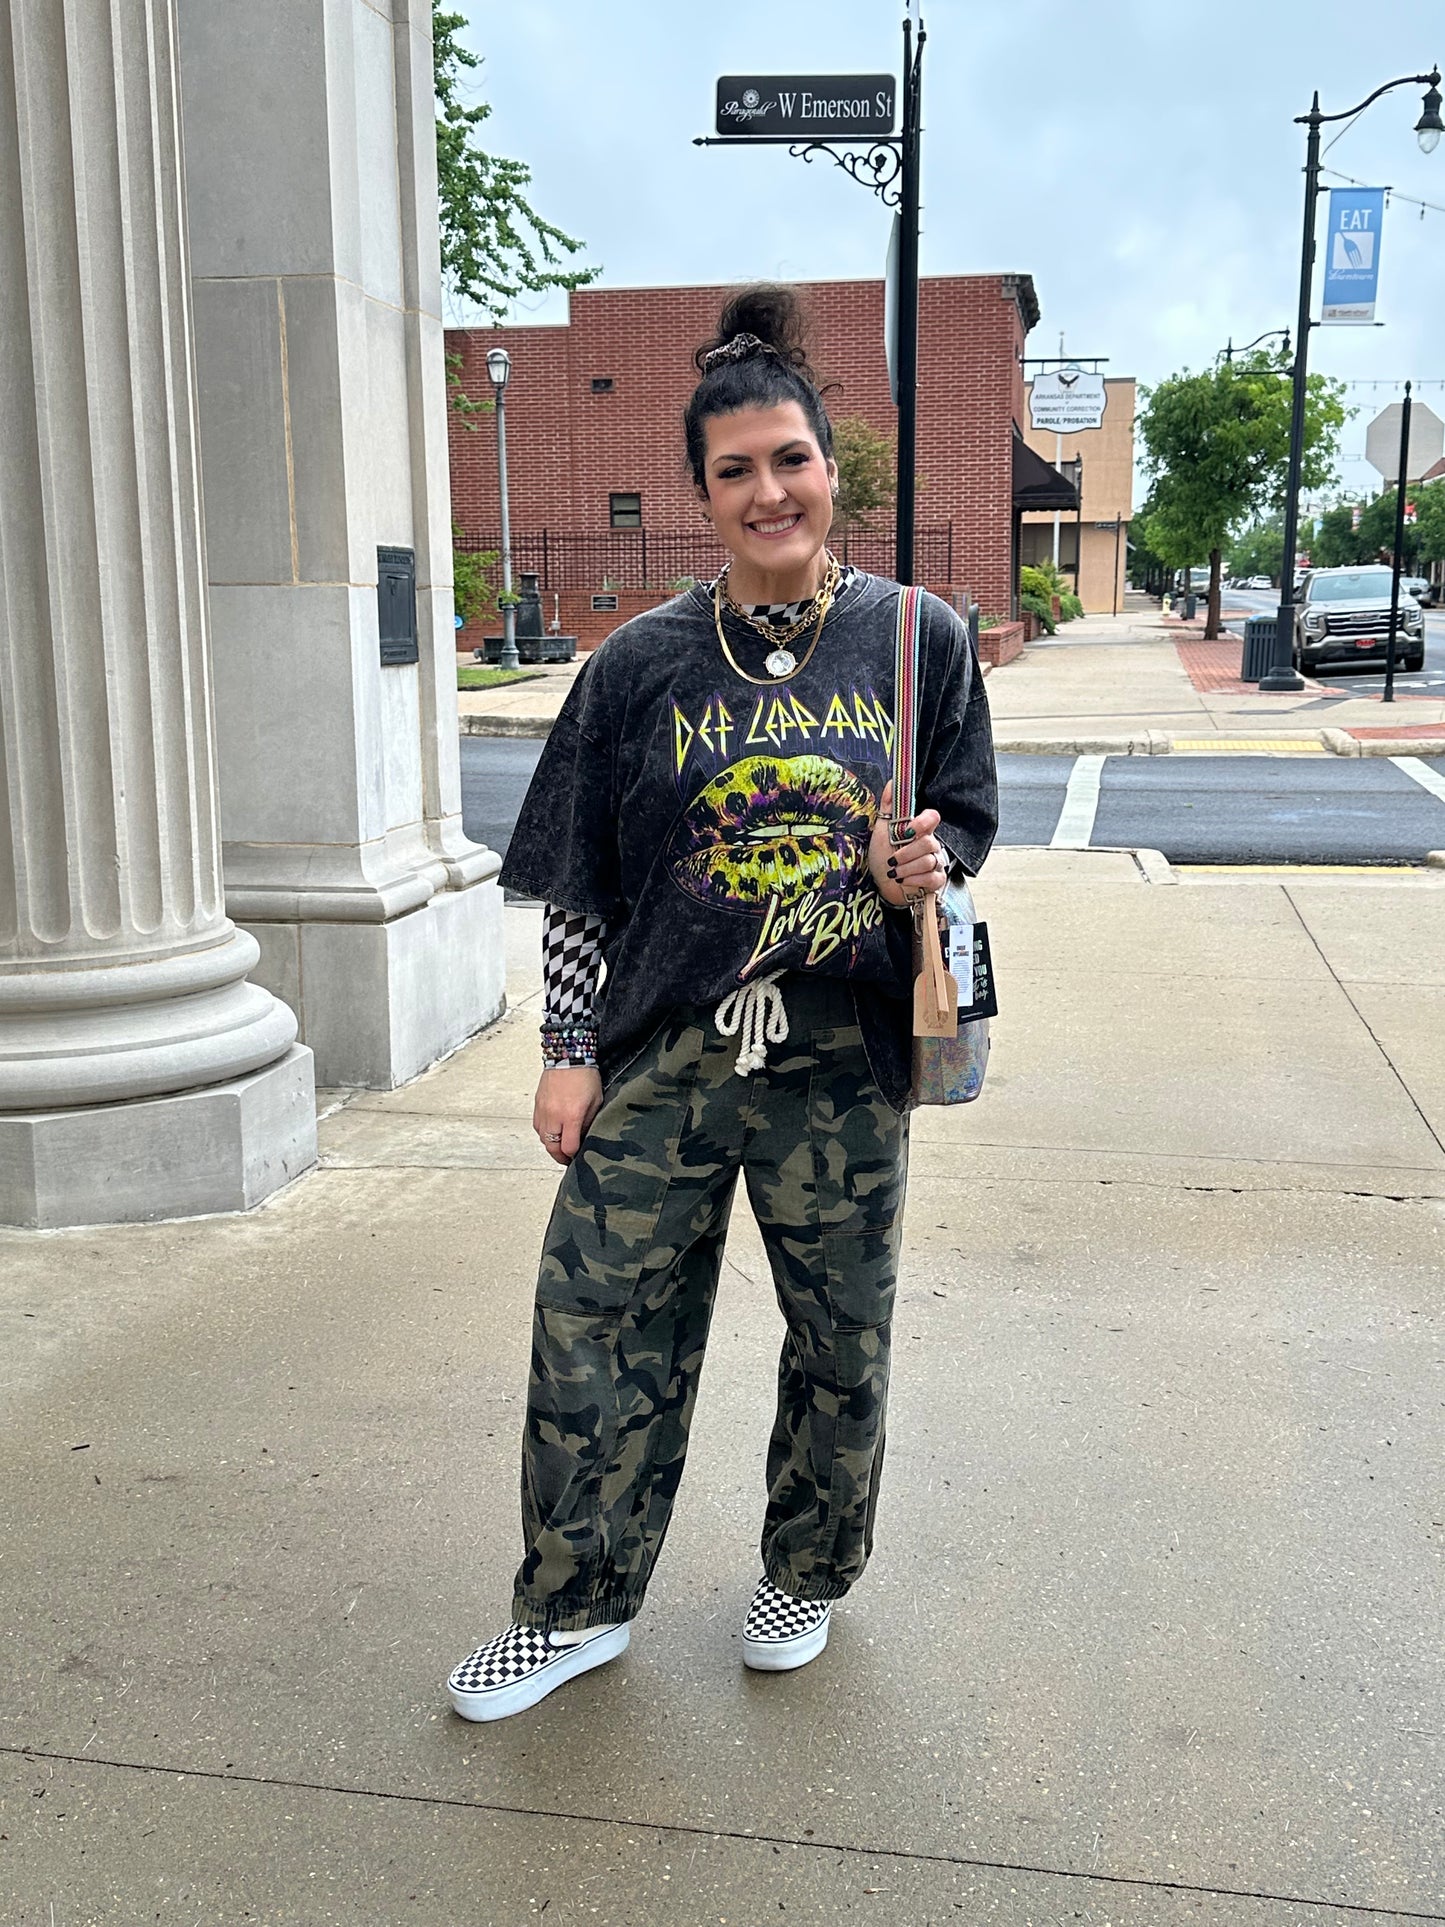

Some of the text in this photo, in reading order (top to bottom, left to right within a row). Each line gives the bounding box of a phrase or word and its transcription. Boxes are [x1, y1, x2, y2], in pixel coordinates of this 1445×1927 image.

[778, 92, 892, 118] W Emerson St
[1340, 209, 1373, 230] EAT
[673, 703, 735, 776] DEF
[739, 888, 884, 981] Love Bites
